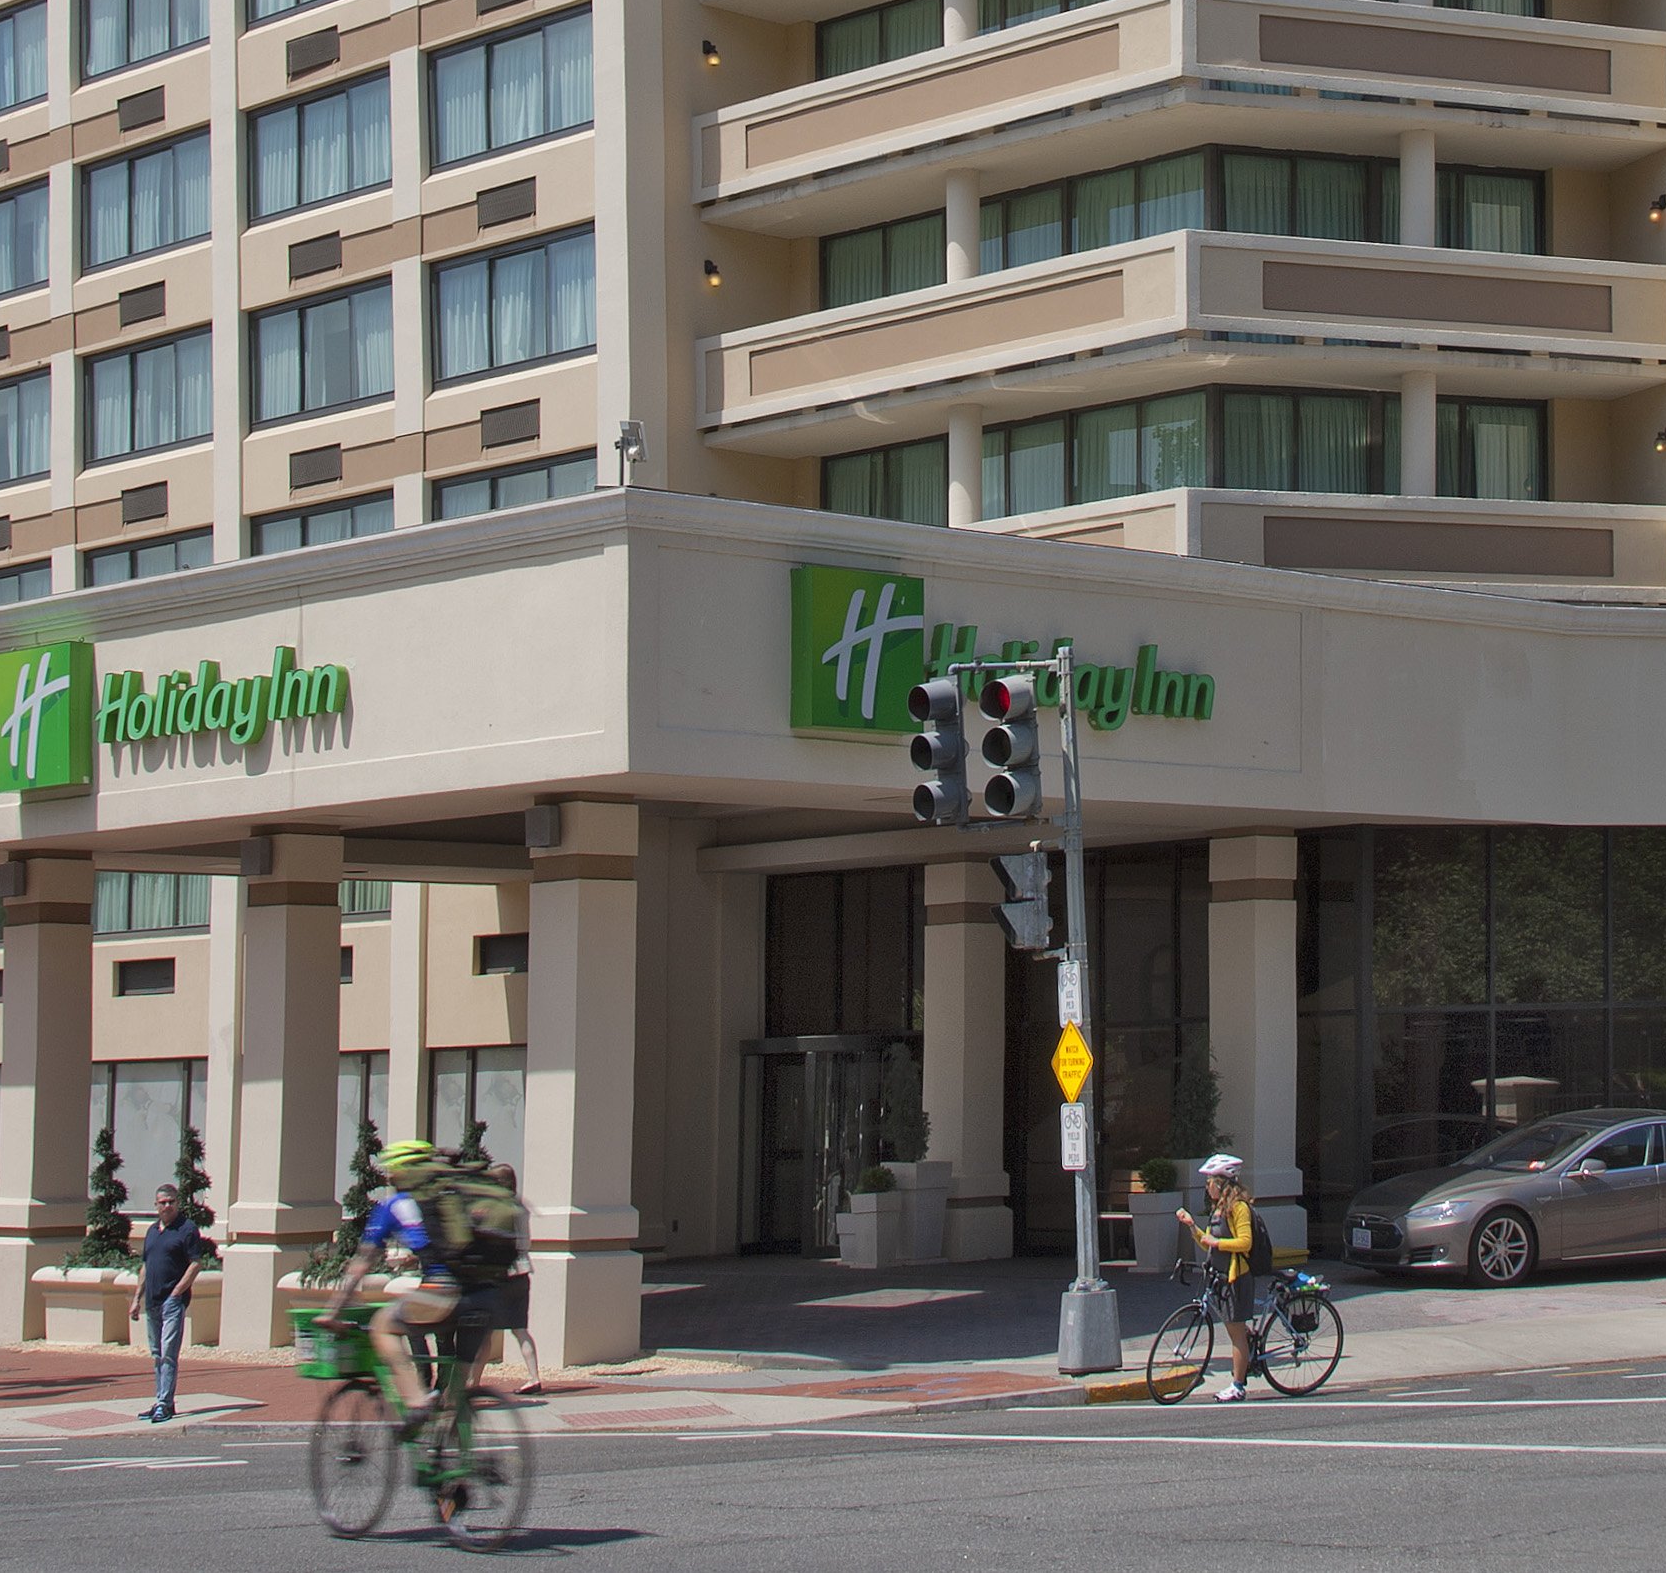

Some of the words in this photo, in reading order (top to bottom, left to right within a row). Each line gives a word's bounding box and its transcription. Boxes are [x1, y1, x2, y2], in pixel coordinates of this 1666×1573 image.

[95, 659, 265, 745] Holiday
[267, 645, 348, 722] Inn
[1132, 643, 1215, 720] Inn
